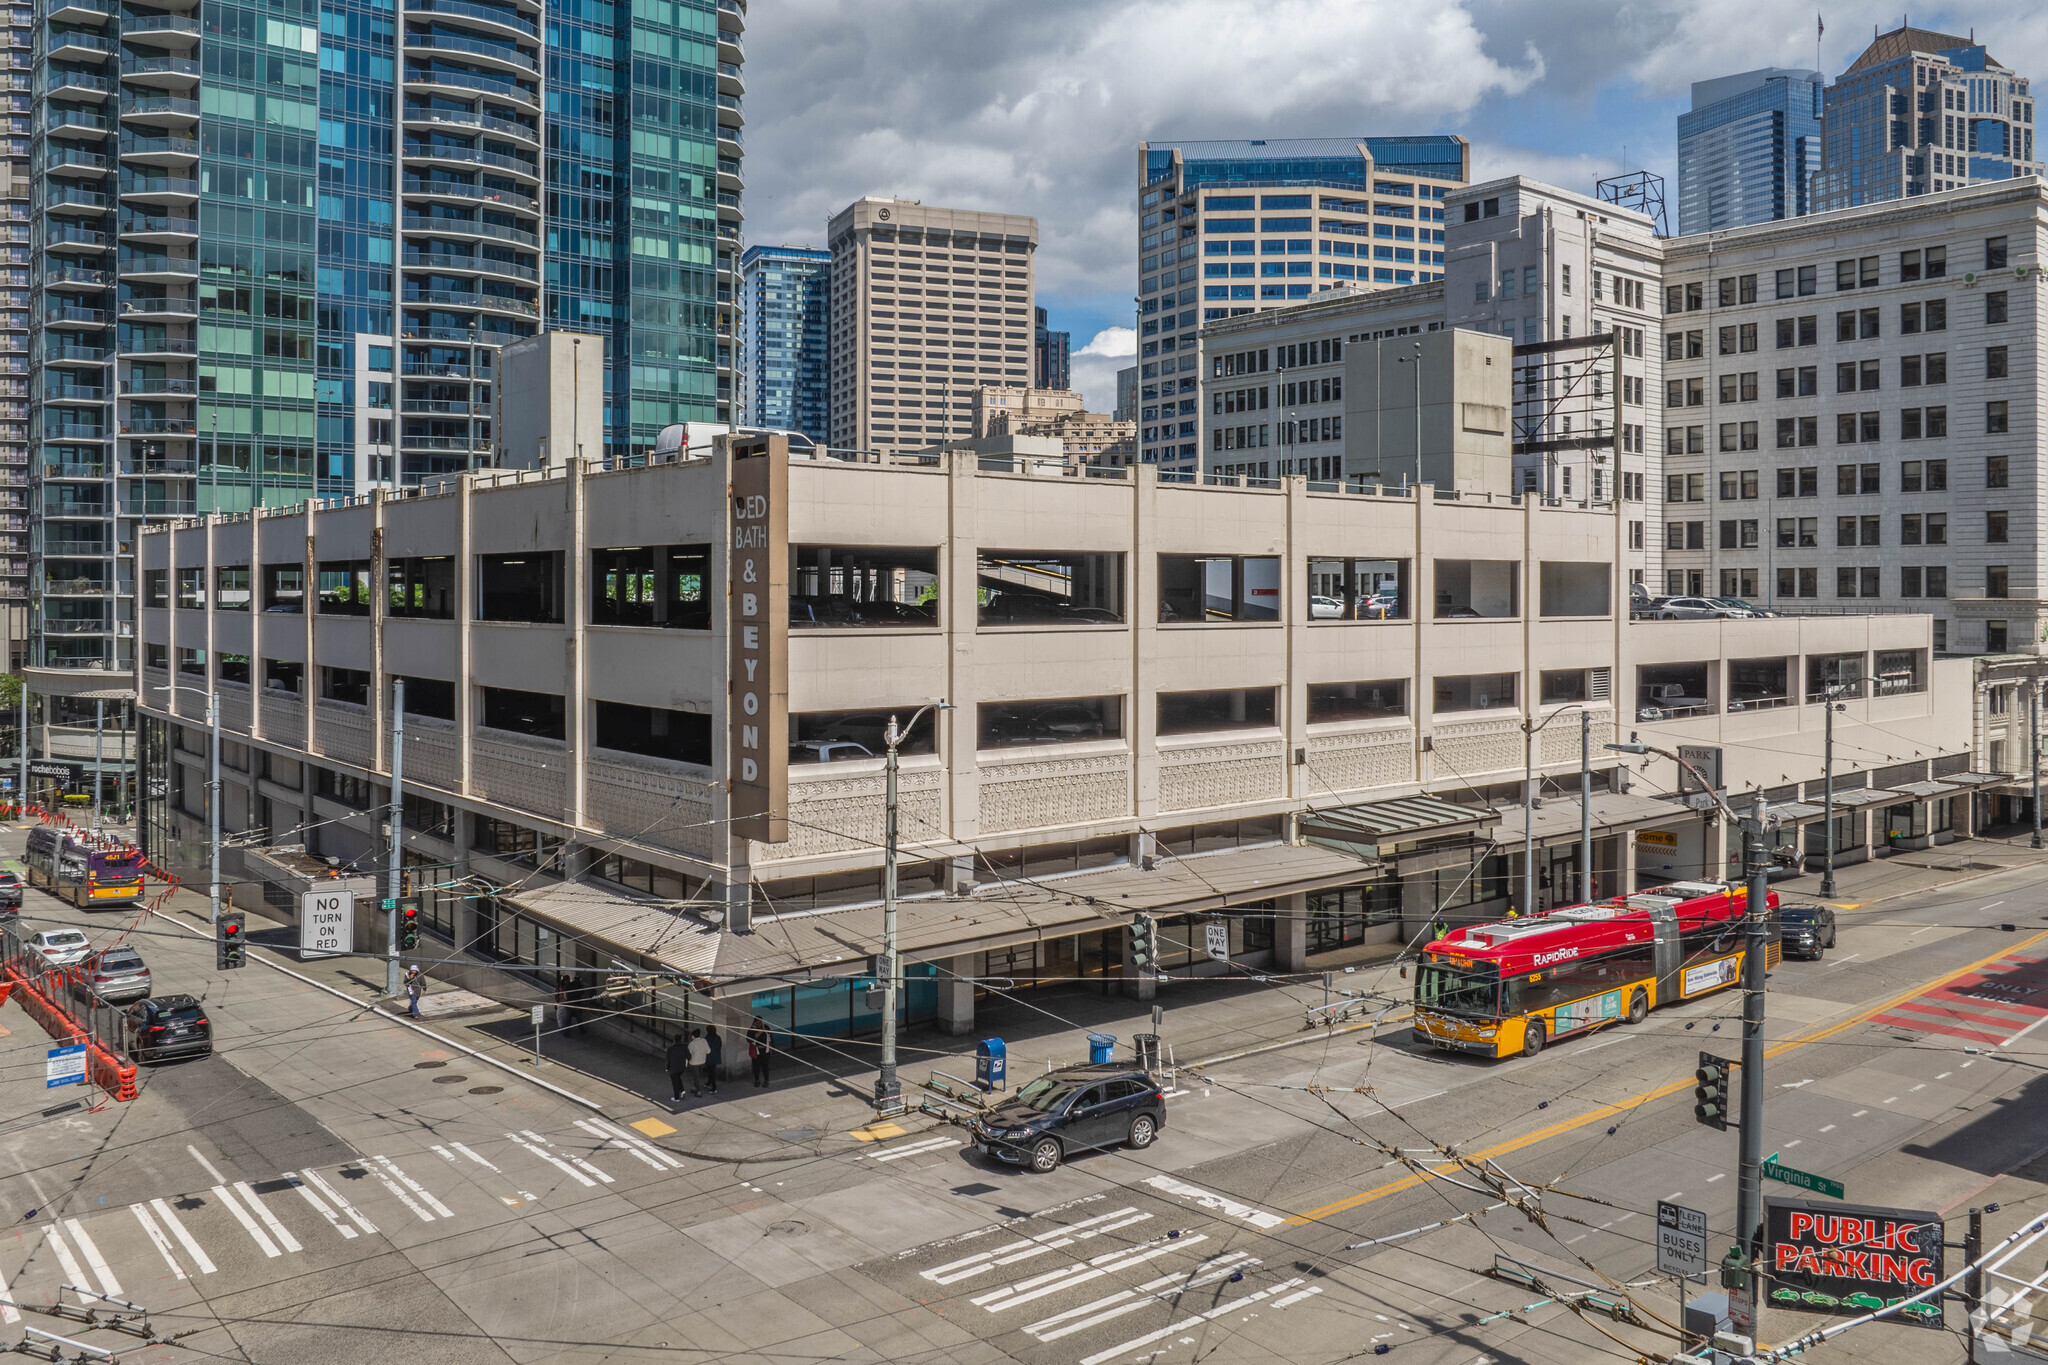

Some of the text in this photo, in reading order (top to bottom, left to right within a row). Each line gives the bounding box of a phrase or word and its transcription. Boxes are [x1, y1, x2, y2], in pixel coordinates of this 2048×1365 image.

[735, 525, 767, 549] BATH
[743, 558, 757, 583] &
[742, 593, 759, 782] BEYOND
[1684, 750, 1711, 760] PARK
[316, 897, 339, 911] NO
[313, 913, 342, 924] TURN
[319, 926, 335, 937] ON
[1208, 927, 1225, 938] ONE
[316, 939, 338, 949] RED
[1208, 937, 1225, 947] WAY
[879, 956, 890, 967] ONE
[879, 965, 890, 975] WAY
[1981, 981, 2039, 995] ONLY
[1767, 1162, 1811, 1187] Virginia
[1818, 1181, 1827, 1192] St
[1682, 1211, 1702, 1223] LEFT
[1682, 1221, 1703, 1234] LANE
[1790, 1212, 1921, 1253] PUBLIC
[1663, 1233, 1700, 1253] BUSES
[1667, 1246, 1697, 1263] ONLY
[1775, 1243, 1936, 1286] PARKING
